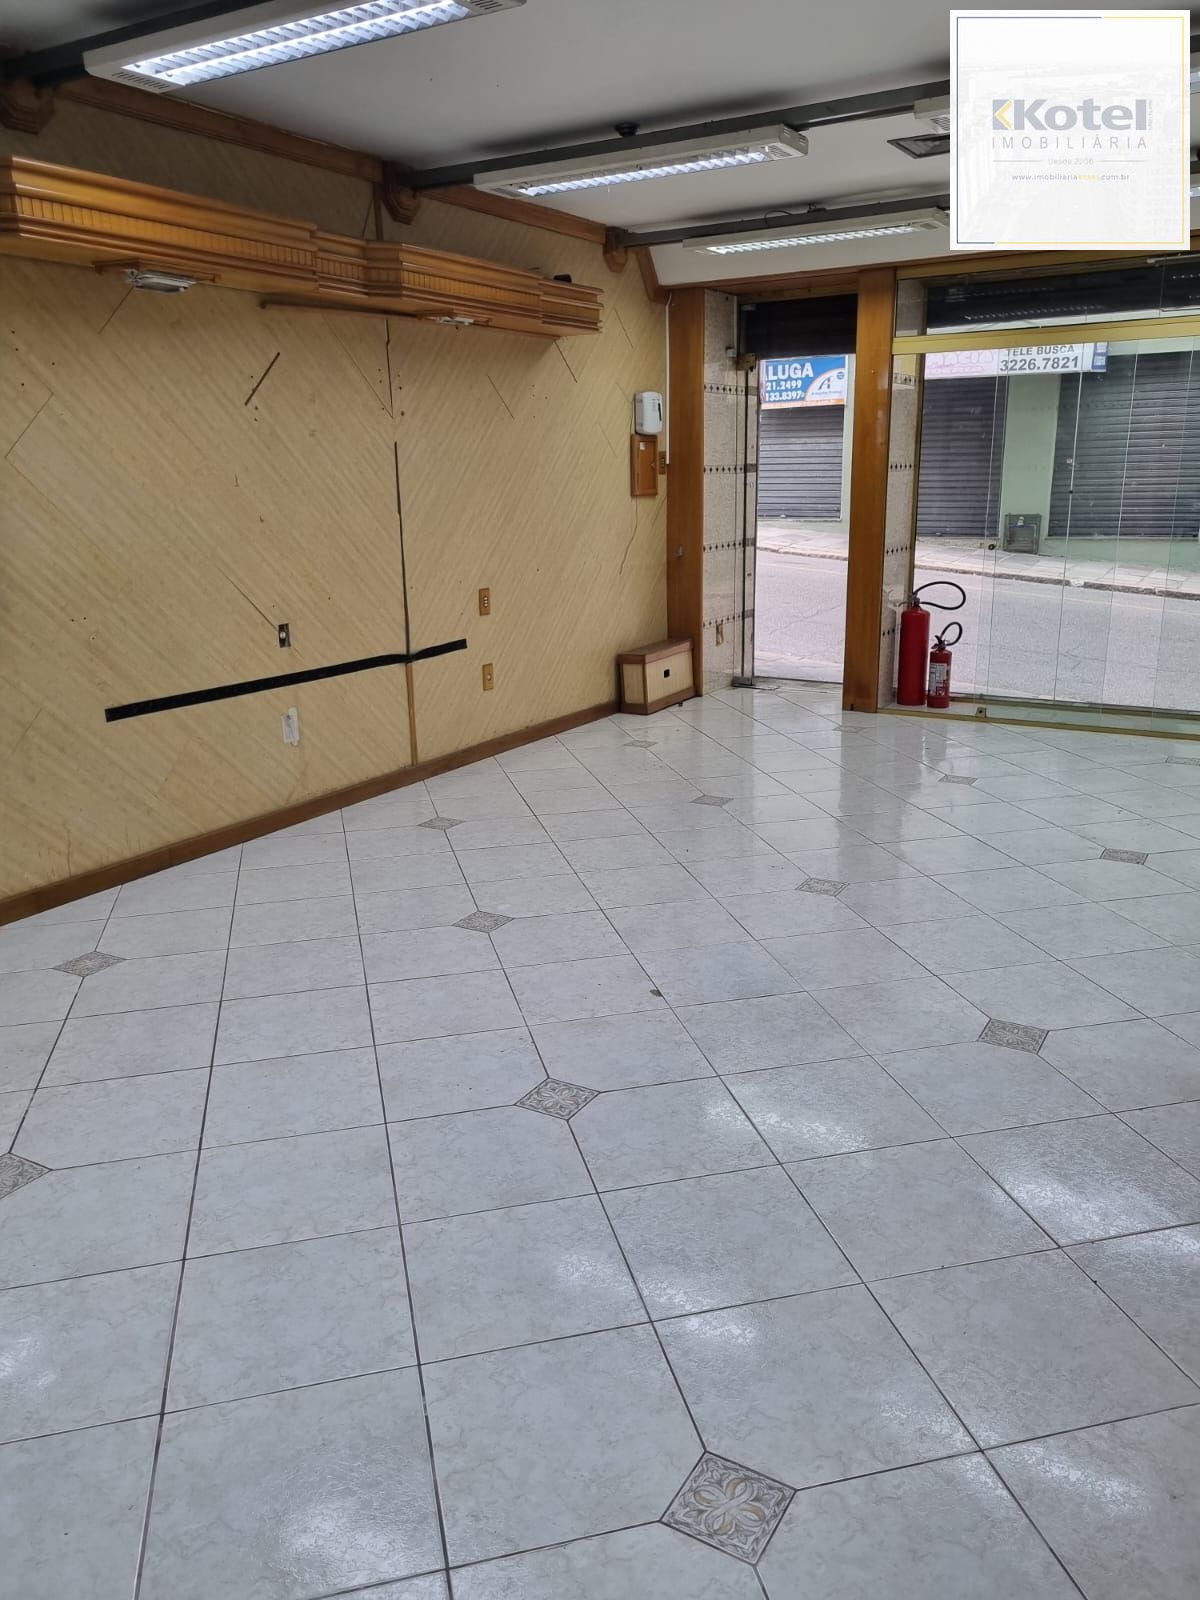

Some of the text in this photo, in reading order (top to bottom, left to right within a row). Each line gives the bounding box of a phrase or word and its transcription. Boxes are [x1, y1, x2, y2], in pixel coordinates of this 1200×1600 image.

[1036, 345, 1075, 356] BUSCA
[766, 362, 814, 380] LUGA
[1000, 355, 1079, 372] 3226.7821
